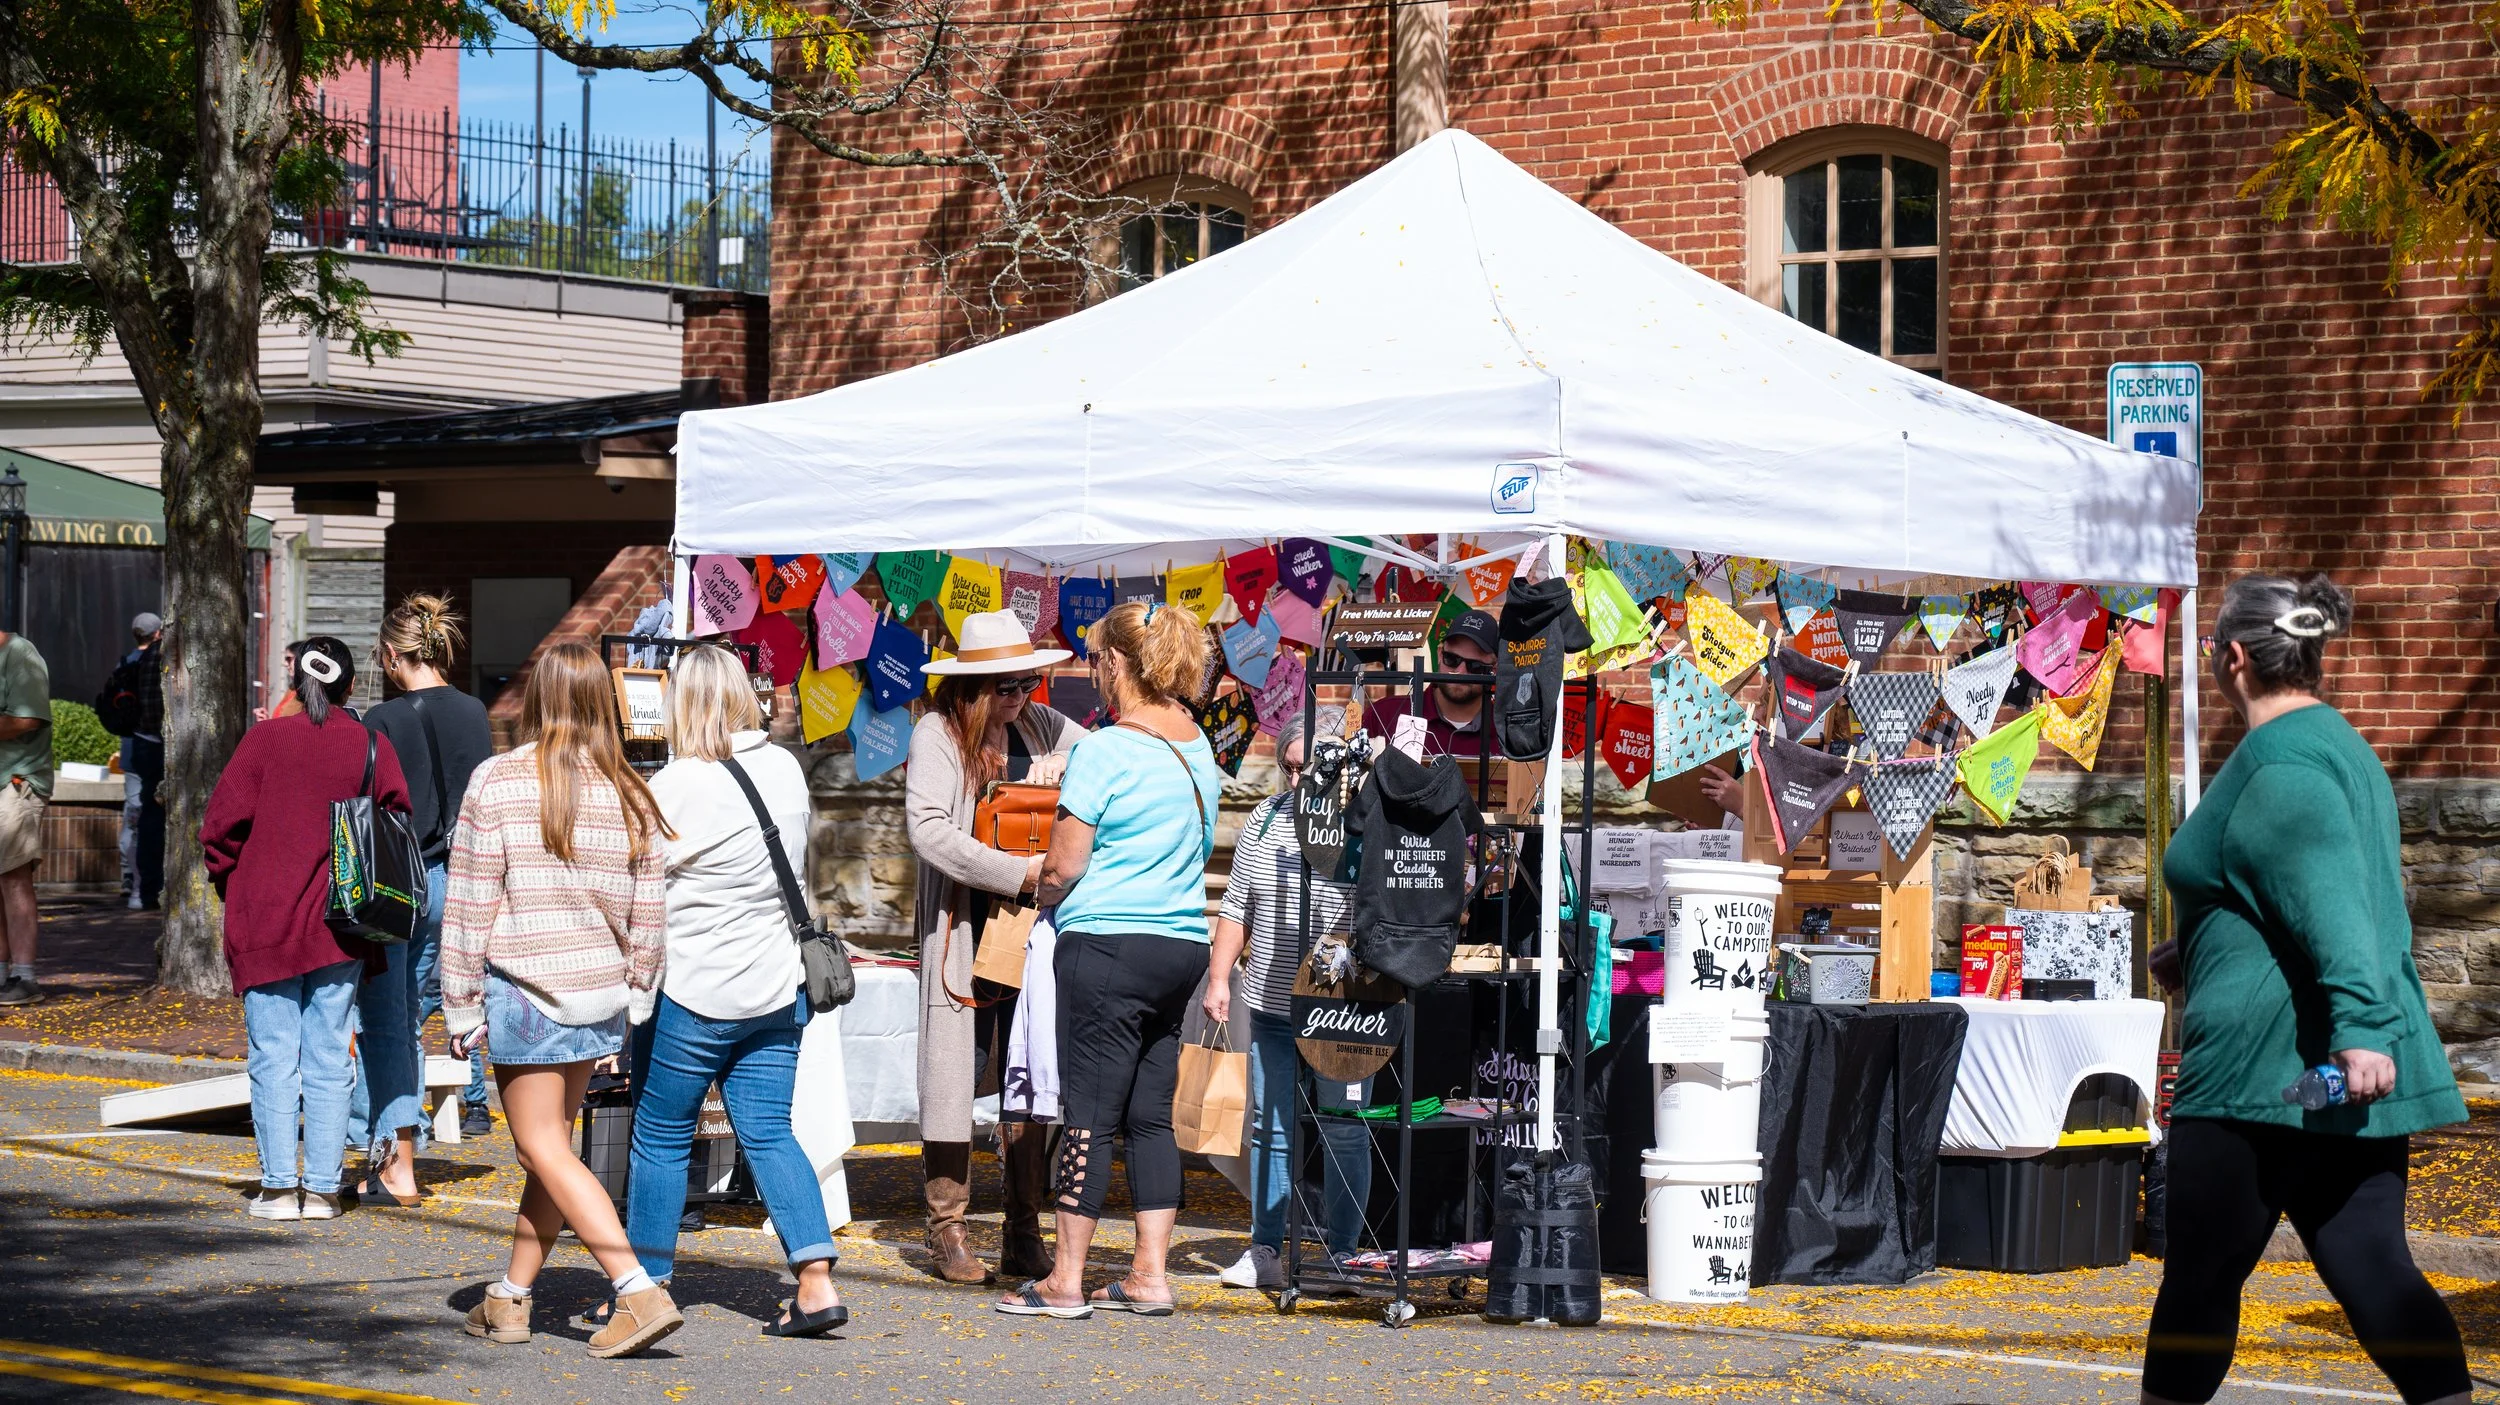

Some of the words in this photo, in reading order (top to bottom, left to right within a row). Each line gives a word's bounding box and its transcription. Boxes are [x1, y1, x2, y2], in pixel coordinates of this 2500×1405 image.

[2115, 378, 2195, 397] RESERVED
[2121, 404, 2190, 424] PARKING
[117, 523, 158, 546] CO.
[903, 551, 926, 571] BAD
[1293, 546, 1316, 565] Street
[778, 565, 799, 589] TROL
[1291, 560, 1324, 578] Walker
[1471, 566, 1502, 582] goodest
[712, 563, 743, 601] Pretty
[952, 572, 971, 590] Wild
[972, 583, 991, 598] Child
[1474, 578, 1500, 592] ghoul
[704, 578, 737, 615] Motha
[950, 589, 968, 601] Wild
[970, 593, 991, 609] Child
[1140, 594, 1155, 604] NOT
[2047, 588, 2057, 599] MY
[698, 590, 725, 626] Fluffa
[949, 599, 967, 611] Wild
[1011, 599, 1039, 612] HEARTS
[1073, 608, 1083, 620] MY
[1340, 610, 1361, 619] Free
[1363, 609, 1392, 619] Whine
[1393, 609, 1401, 618] &
[1403, 609, 1432, 618] Licker
[2036, 596, 2058, 615] PARENTS
[1808, 616, 1838, 632] SPOO
[1234, 627, 1261, 651] BRANCH
[1354, 631, 1372, 644] Dog
[1371, 630, 1385, 642] For
[1387, 630, 1414, 642] Details
[1701, 625, 1736, 660] Shotgun
[1860, 634, 1877, 646] LAB
[2044, 632, 2068, 656] BRANCH
[1236, 635, 1268, 660] MANAGER
[1811, 644, 1848, 660] PUPPE
[2042, 640, 2072, 667] MANAGER
[1700, 647, 1728, 671] Rider
[877, 660, 911, 689] Handsome
[808, 686, 840, 716] PERSONAL
[819, 682, 837, 702] DAD'S
[1966, 682, 1996, 708] Needy
[806, 697, 834, 723] STALKER
[1798, 700, 1813, 713] THAT
[1974, 701, 1990, 725] AF
[871, 716, 896, 735] MOM'S
[1619, 728, 1635, 740] TOO
[1636, 732, 1651, 742] OLD
[862, 735, 895, 757] STALKER
[1613, 738, 1651, 760] sheet
[1991, 762, 2015, 782] HEARTS
[1782, 790, 1815, 810] Handsome
[1896, 787, 1914, 798] Wild
[1996, 783, 2014, 800] FARTS
[1300, 788, 1335, 825] hey
[1890, 809, 1918, 823] Cuddly
[1307, 818, 1345, 847] boo!
[1700, 833, 1709, 841] It's
[1709, 834, 1720, 842] Just
[1834, 829, 1864, 841] What's
[1866, 830, 1881, 843] Up
[1400, 835, 1431, 849] Wild
[1698, 841, 1712, 850] My
[1713, 842, 1731, 850] Mom
[1838, 843, 1877, 854] Britches?
[1385, 849, 1394, 860] IN
[1395, 850, 1412, 860] THE
[1413, 850, 1446, 861] STREETS
[1702, 850, 1717, 858] Always
[1393, 861, 1437, 878] Cuddly
[1386, 877, 1397, 888] IN
[1399, 878, 1413, 888] THE
[1415, 877, 1444, 889] SHEETS
[1714, 902, 1773, 923] WELCOME
[1727, 920, 1742, 934] TO
[1746, 922, 1766, 935] OUR
[1714, 935, 1769, 953] CAMPSITE
[1964, 939, 2007, 951] medium
[1972, 960, 1988, 970] joy!
[1301, 1002, 1388, 1037] gather
[1336, 1043, 1373, 1056] SOMEWHERE
[1375, 1047, 1389, 1057] ELSE
[700, 1119, 734, 1135] Bourbo
[1723, 1215, 1738, 1228] TO
[1740, 1215, 1755, 1228] CAM
